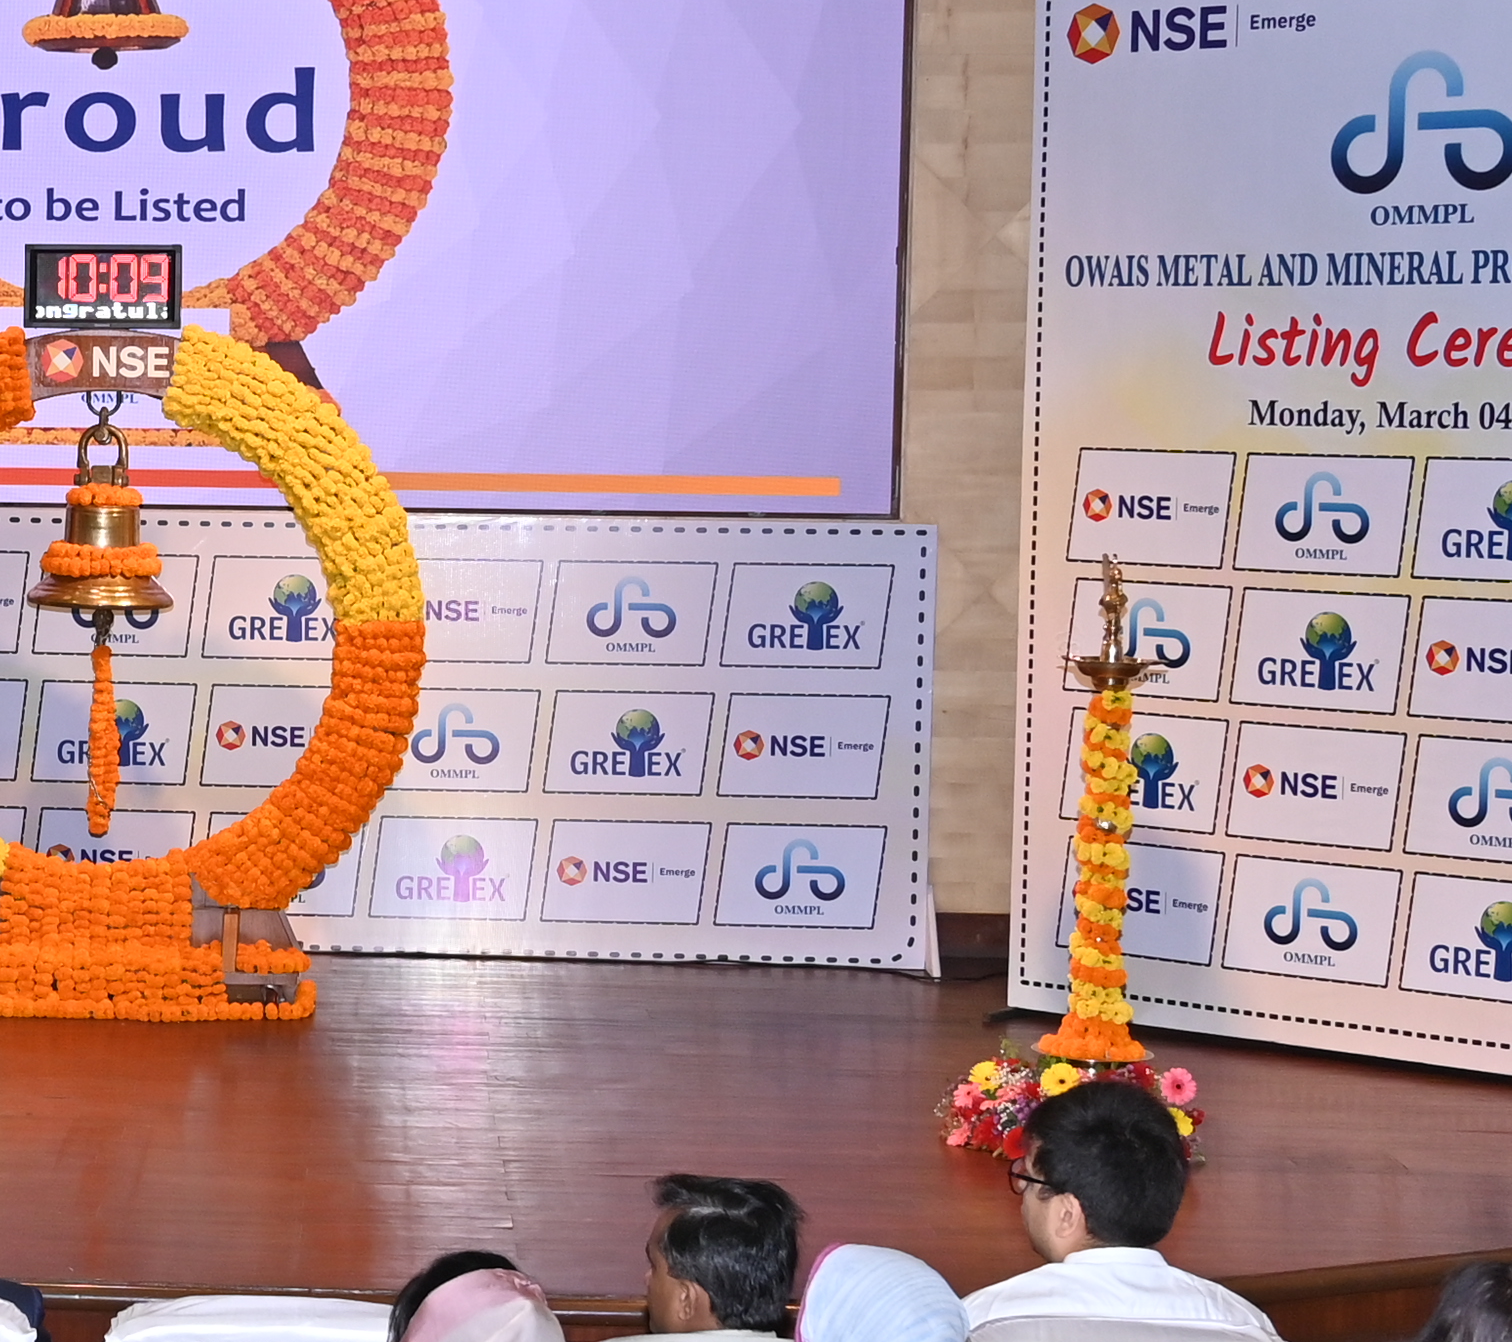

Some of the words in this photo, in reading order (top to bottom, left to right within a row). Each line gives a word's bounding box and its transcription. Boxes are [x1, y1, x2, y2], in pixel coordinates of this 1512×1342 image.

[1131, 6, 1227, 52] NSE
[1251, 14, 1316, 31] Emerge
[47, 188, 99, 221] be
[115, 188, 245, 222] Listed
[1371, 204, 1474, 225] OMMPL
[58, 254, 169, 302] 10:09
[1066, 255, 1149, 287] OWAIS
[1157, 254, 1252, 286] METAL
[1258, 253, 1317, 286] AND
[1326, 251, 1463, 286] MINERAL
[93, 346, 170, 378] NSE
[1209, 311, 1379, 387] Listing
[1249, 400, 1365, 435] Monday,
[1376, 402, 1469, 429] March
[1119, 495, 1171, 520] NSE
[1184, 503, 1219, 515] Emerge
[1295, 548, 1347, 560] OMMPL
[426, 599, 480, 621] NSE
[748, 621, 861, 651] GRETEX
[252, 726, 305, 747] NSE
[771, 736, 825, 757] NSE
[570, 749, 682, 778] GRETEX
[1281, 772, 1337, 799] NSE
[594, 861, 647, 883] NSE
